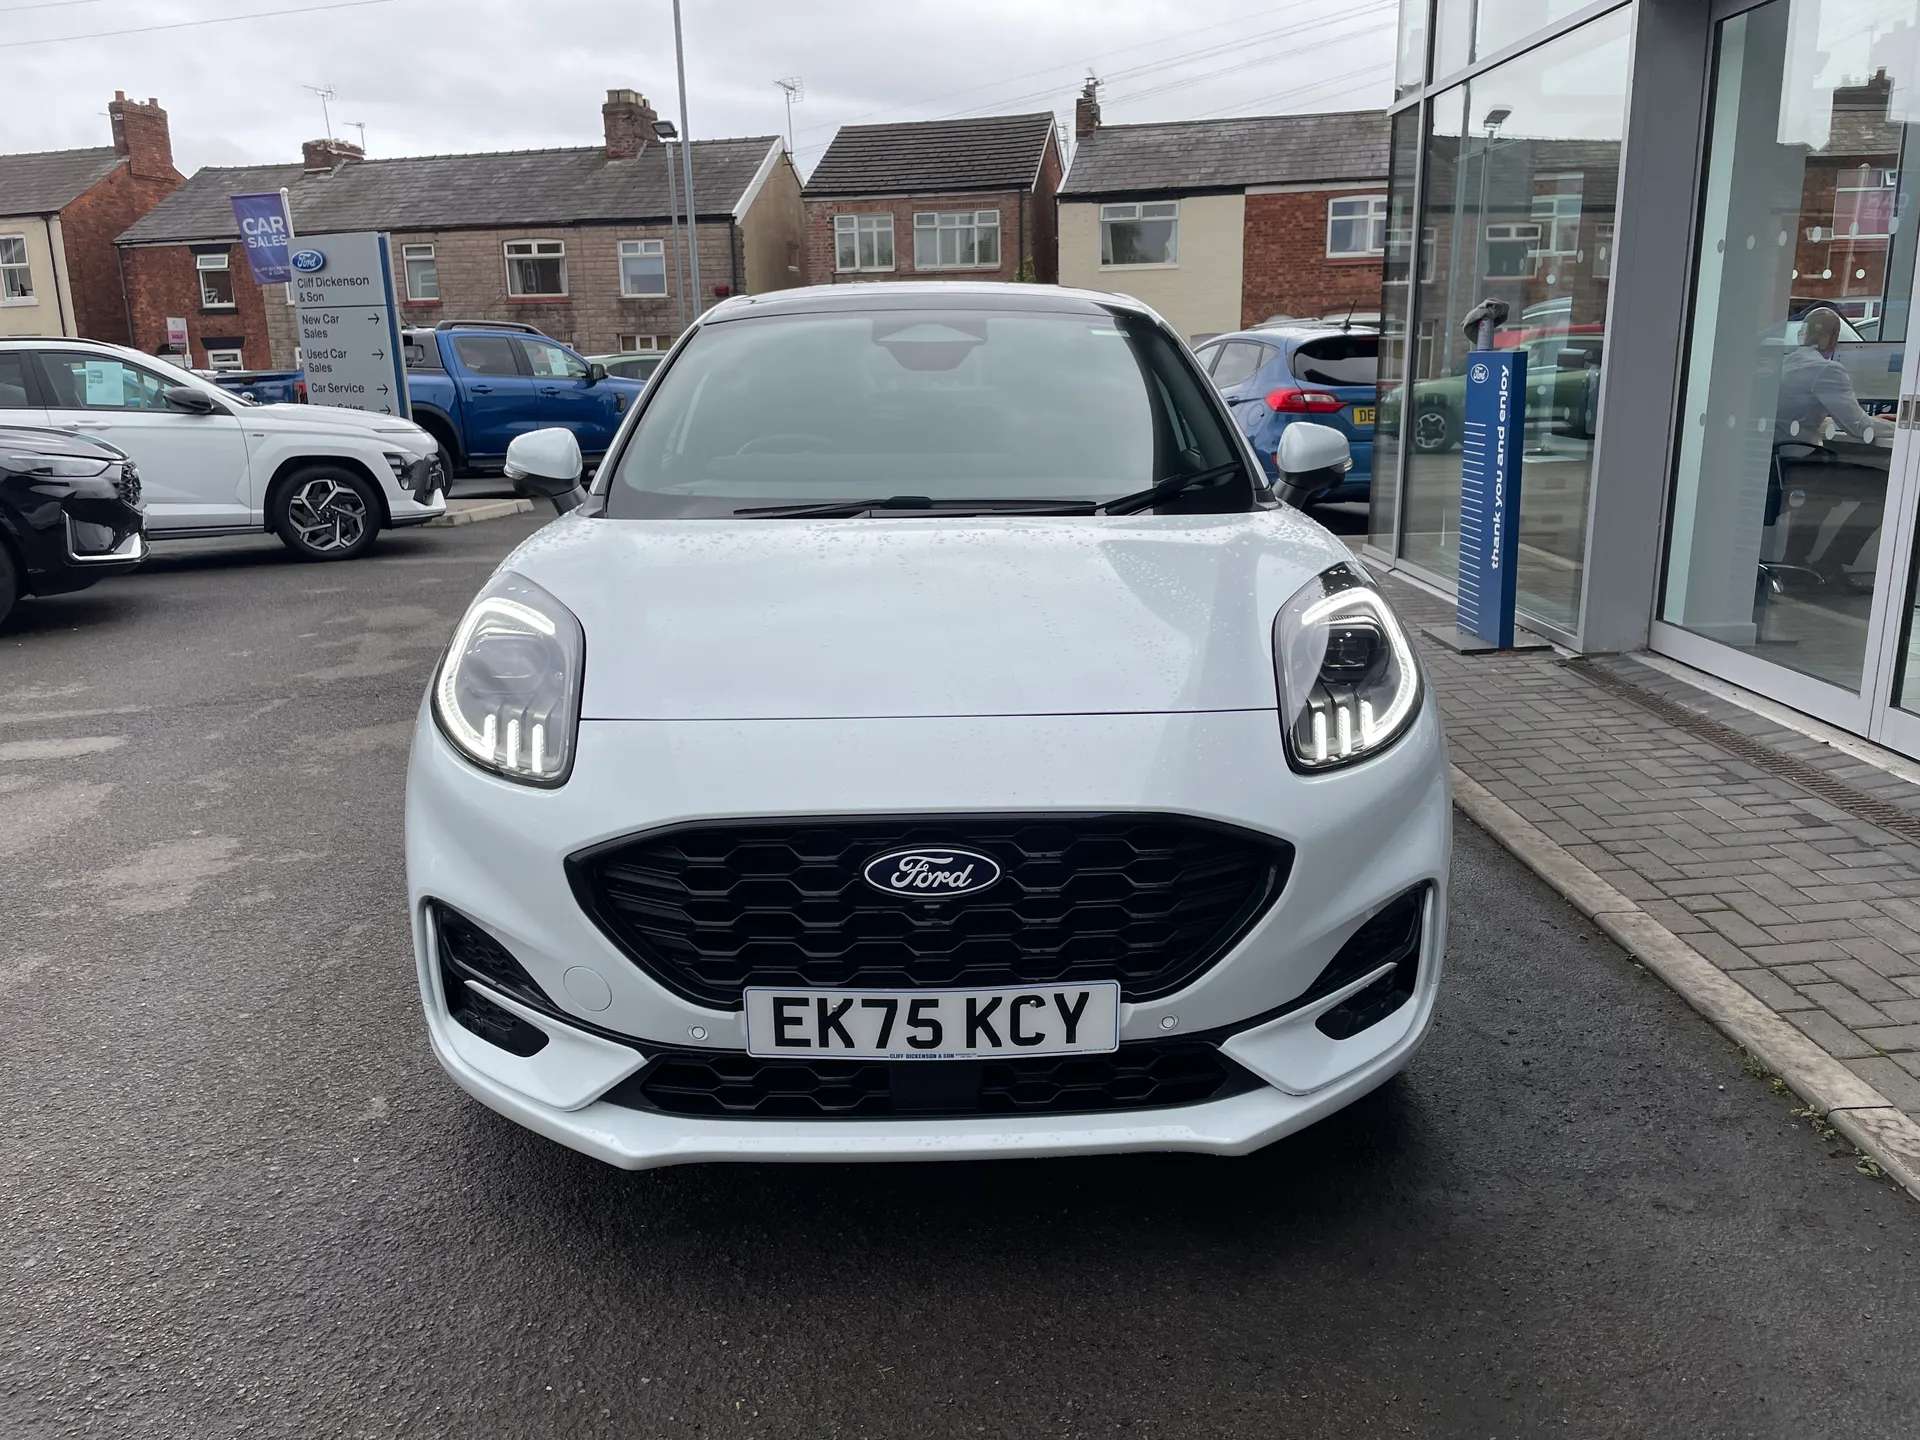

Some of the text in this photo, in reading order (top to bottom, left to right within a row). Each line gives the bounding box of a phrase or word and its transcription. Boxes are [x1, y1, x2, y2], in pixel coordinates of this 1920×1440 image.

[242, 216, 285, 235] CAR
[248, 234, 288, 249] SALES
[297, 275, 370, 289] Cliff Dickenson
[299, 292, 325, 302] & Son
[302, 314, 340, 326] New Car
[304, 328, 328, 339] Sales
[306, 349, 347, 360] Used Car
[308, 362, 333, 373] Sales
[311, 382, 365, 393] Car Service
[1491, 364, 1510, 570] thank you and enjoy
[890, 855, 975, 888] Ford
[772, 991, 1090, 1050] EK75 KCY
